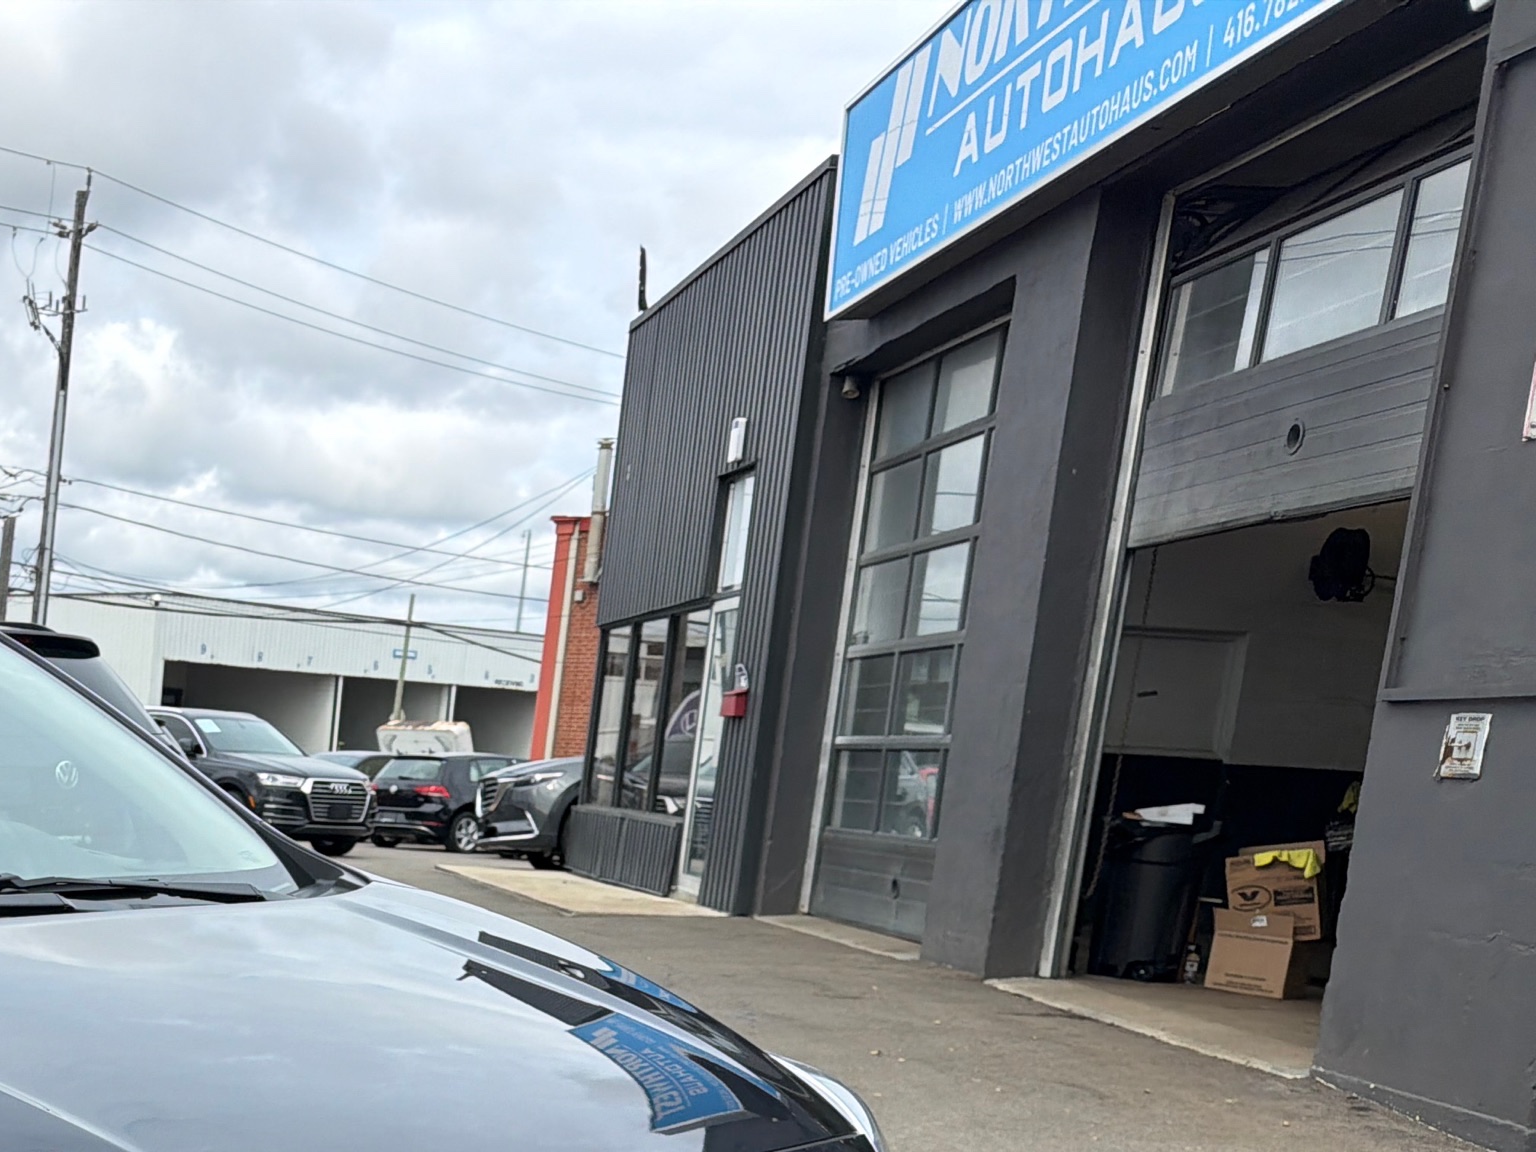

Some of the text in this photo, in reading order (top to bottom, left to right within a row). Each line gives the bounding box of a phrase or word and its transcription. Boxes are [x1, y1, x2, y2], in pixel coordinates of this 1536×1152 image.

[834, 247, 888, 301] PRE-OWNED
[889, 213, 940, 265] VEHICLES
[953, 39, 1198, 224] WWW.NORTHWESTAUTOHAUS.COM
